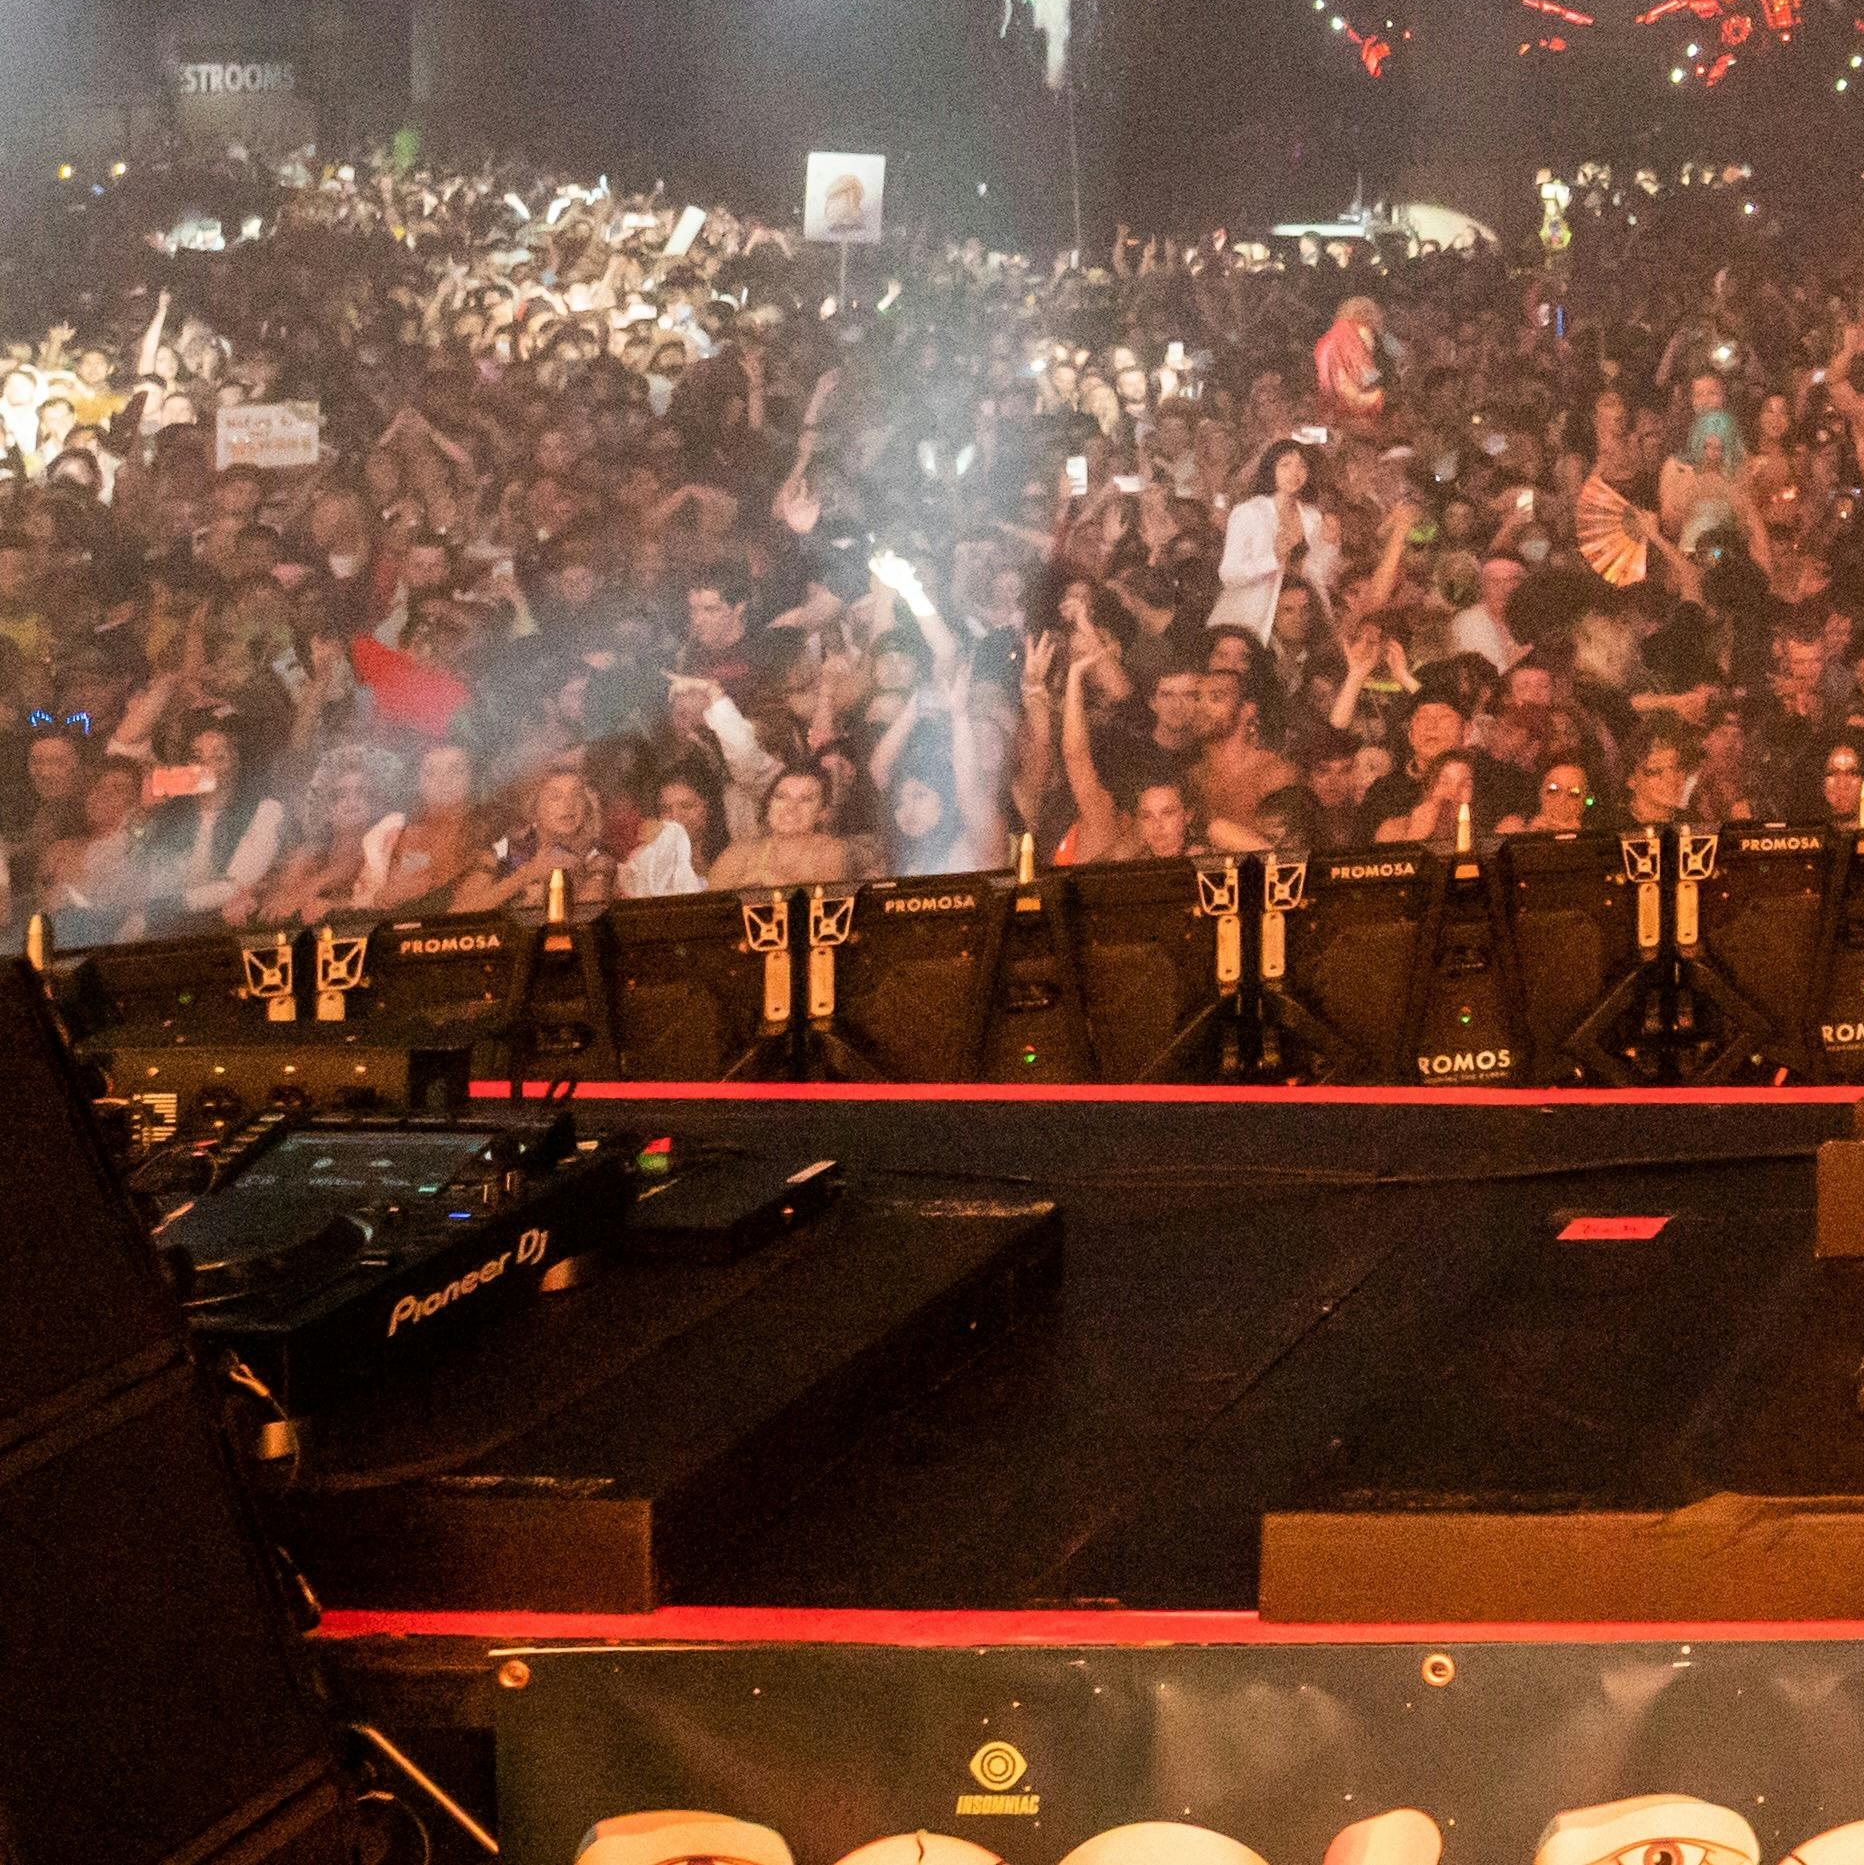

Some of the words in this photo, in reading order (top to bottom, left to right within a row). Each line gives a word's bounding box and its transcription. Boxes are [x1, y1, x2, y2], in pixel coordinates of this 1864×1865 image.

[1740, 836, 1821, 851] PROMOSA
[1330, 861, 1415, 879] PROMOSA
[884, 895, 976, 913] PROMOSA
[400, 934, 501, 954] PROMOSA
[387, 1251, 513, 1338] Pioneer
[955, 1794, 1041, 1816] INSOMNIAC
